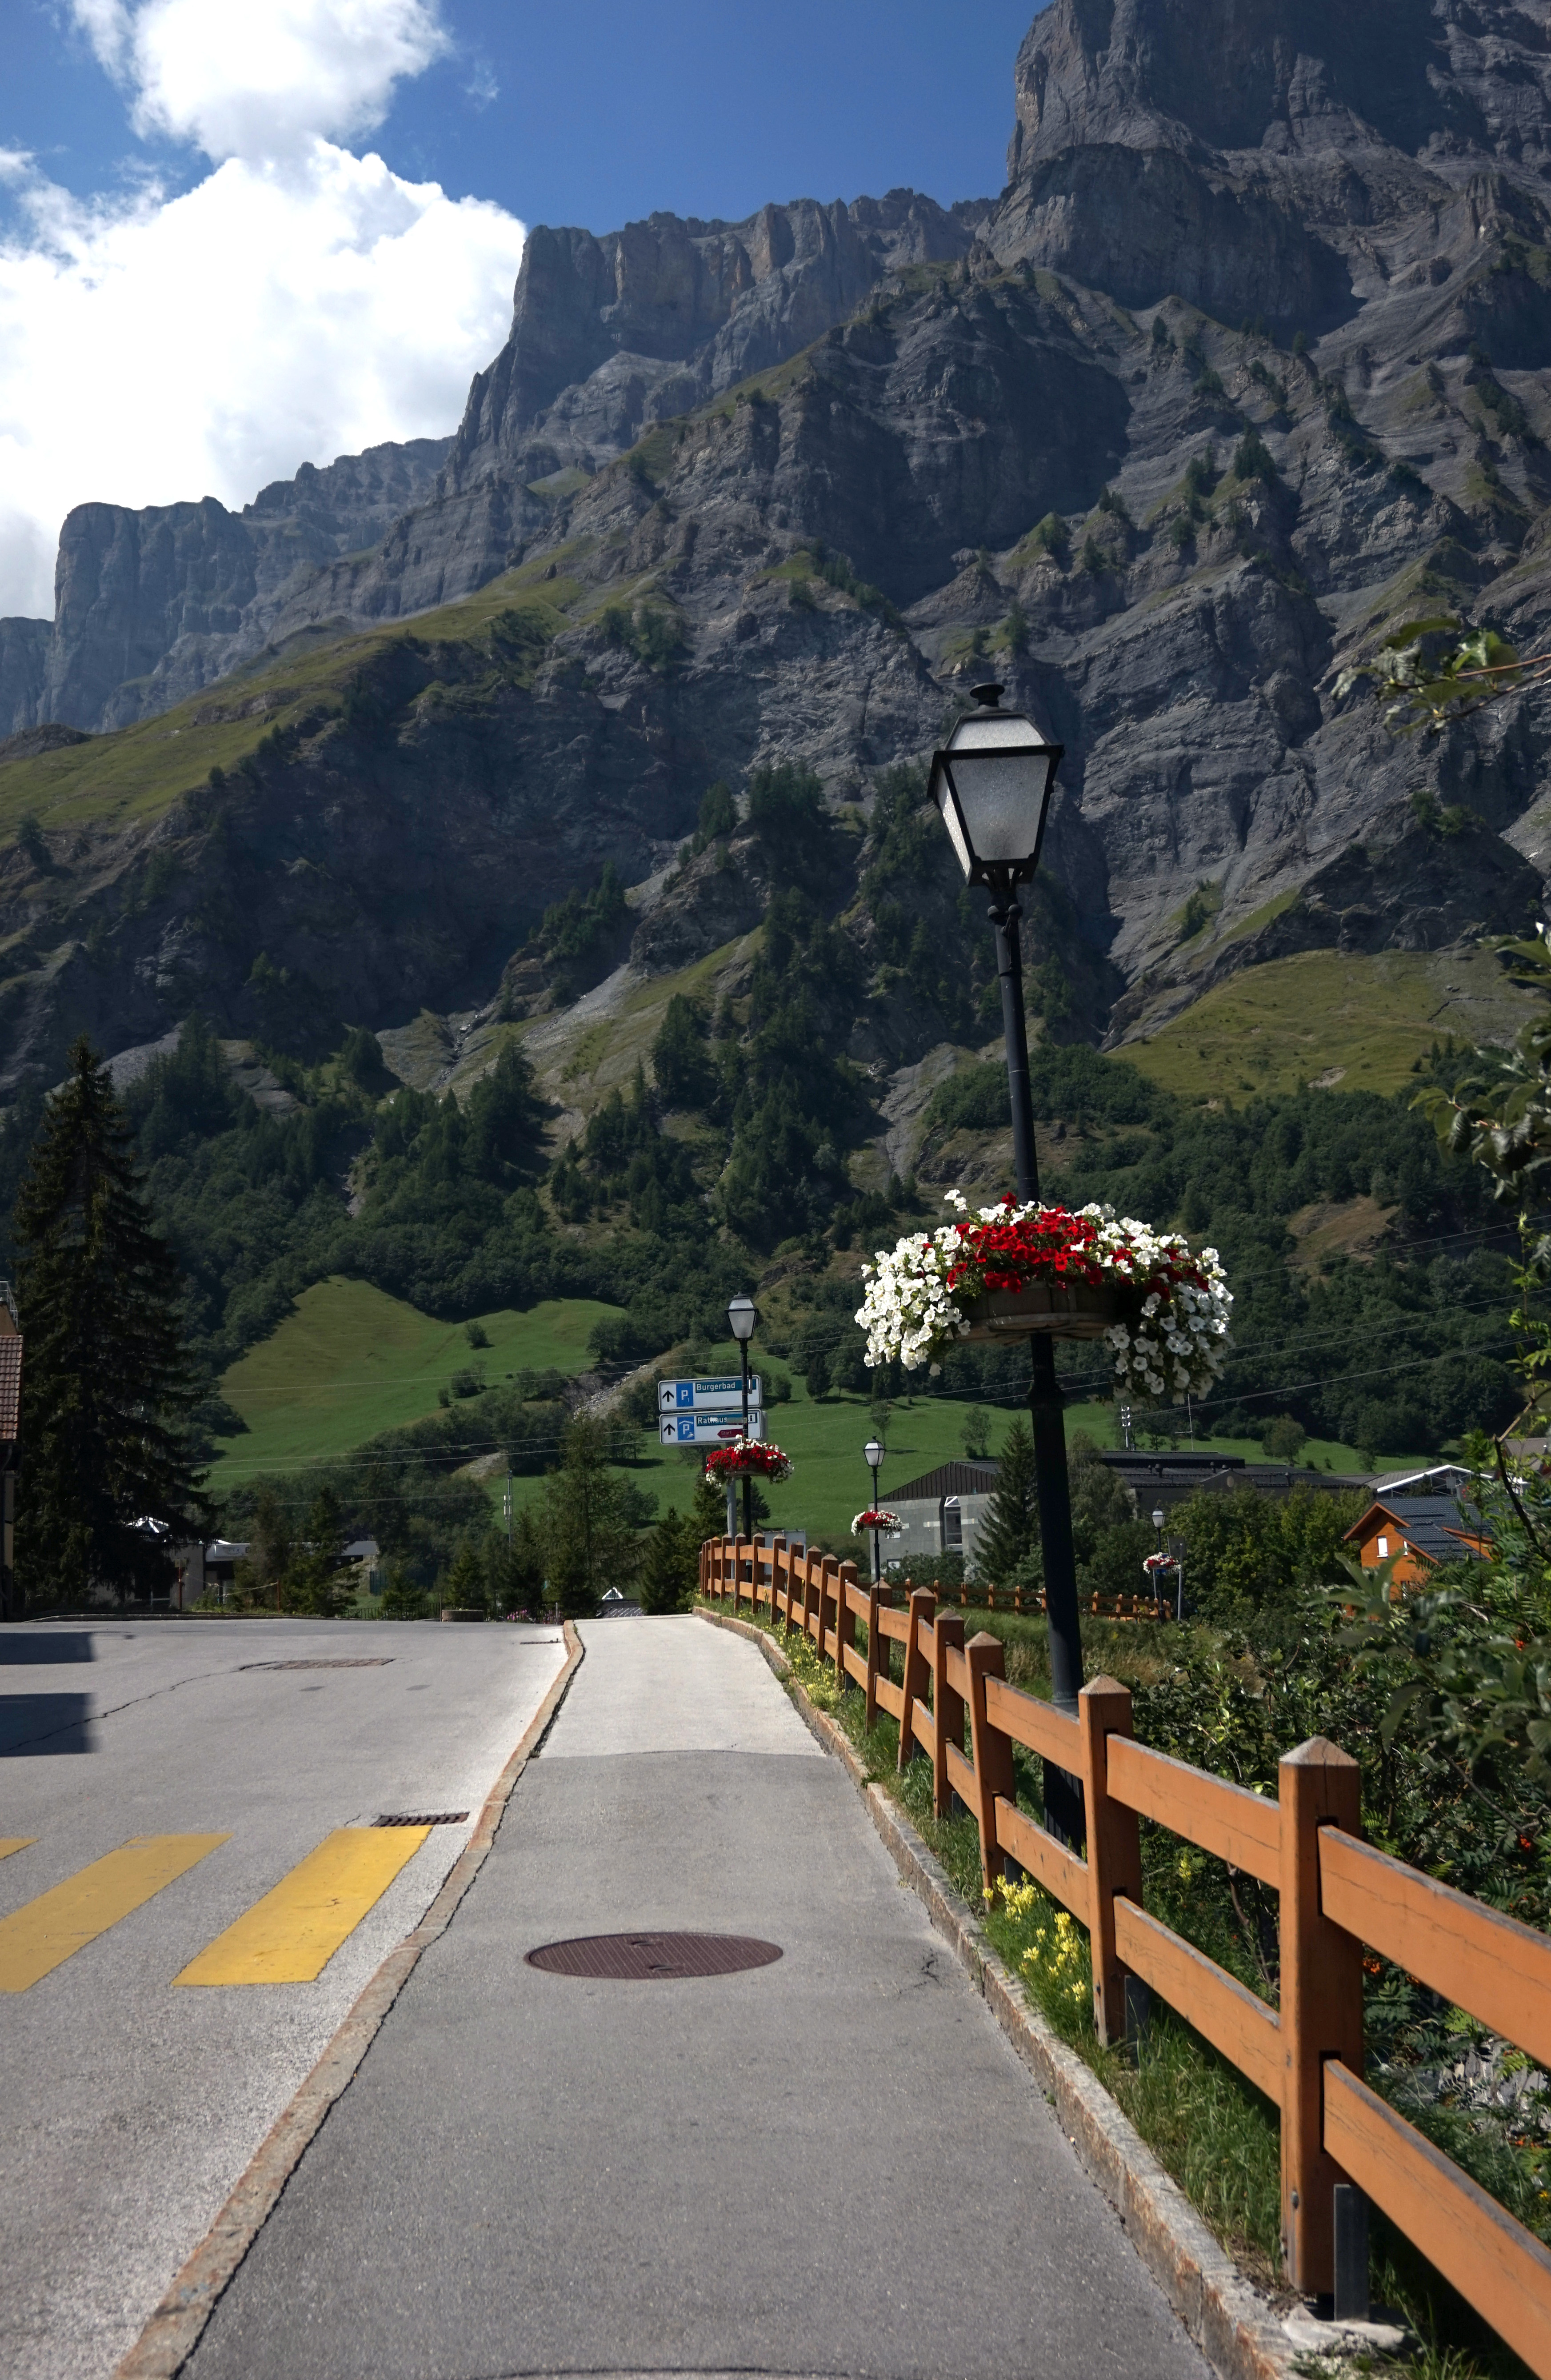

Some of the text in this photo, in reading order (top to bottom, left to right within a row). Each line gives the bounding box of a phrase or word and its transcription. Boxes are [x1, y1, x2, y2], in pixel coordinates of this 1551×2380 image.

[696, 1382, 736, 1392] Burgerbad
[681, 1390, 688, 1400] P
[683, 1424, 690, 1434] P
